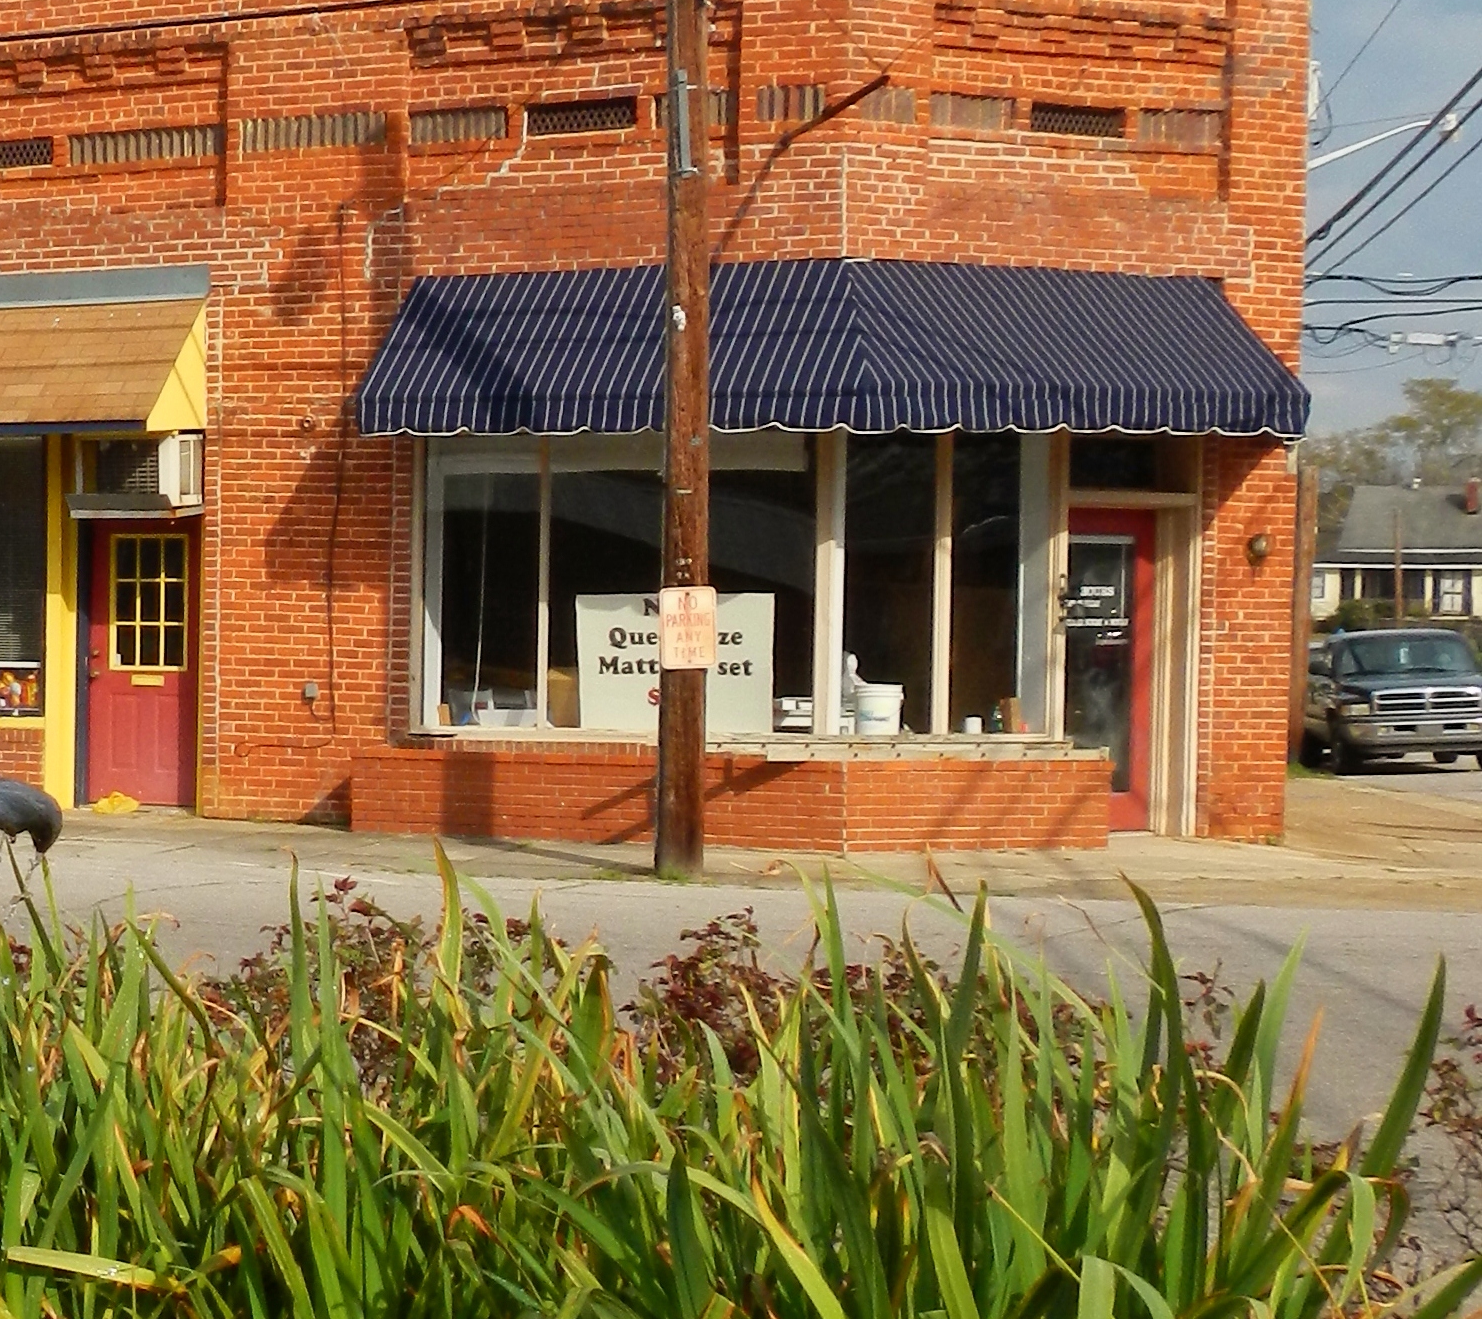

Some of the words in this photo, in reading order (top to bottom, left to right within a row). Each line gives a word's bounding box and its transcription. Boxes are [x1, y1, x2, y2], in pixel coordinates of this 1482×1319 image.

[643, 597, 660, 617] N
[678, 595, 698, 610] NO
[666, 612, 711, 628] PARKING
[608, 627, 658, 650] Que
[718, 631, 743, 646] ze
[675, 631, 702, 643] ANY
[673, 646, 706, 659] TIME
[598, 655, 660, 675] Matt
[718, 659, 753, 677] set
